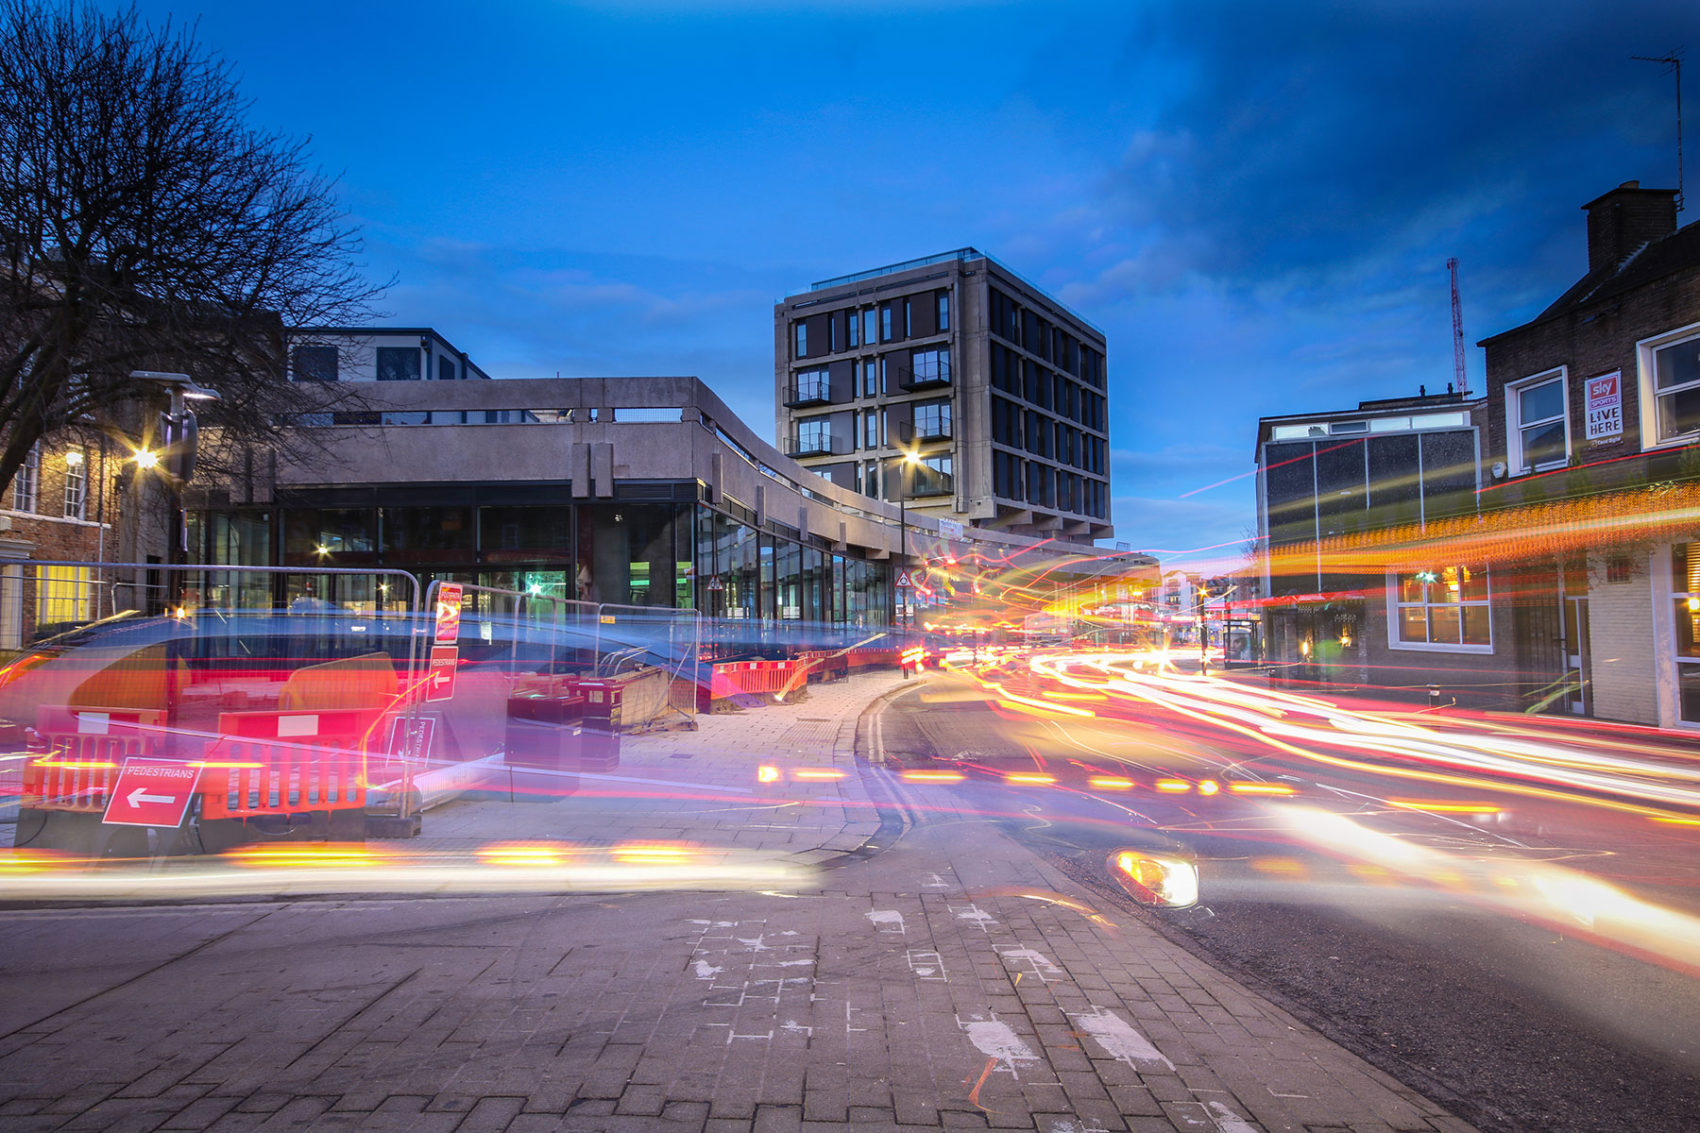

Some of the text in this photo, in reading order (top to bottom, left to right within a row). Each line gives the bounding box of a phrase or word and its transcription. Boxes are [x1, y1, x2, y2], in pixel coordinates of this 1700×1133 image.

[1592, 381, 1612, 395] sky
[1590, 407, 1620, 423] LIVE
[1590, 420, 1621, 435] HERE
[127, 766, 194, 778] PEDESTRIANS
